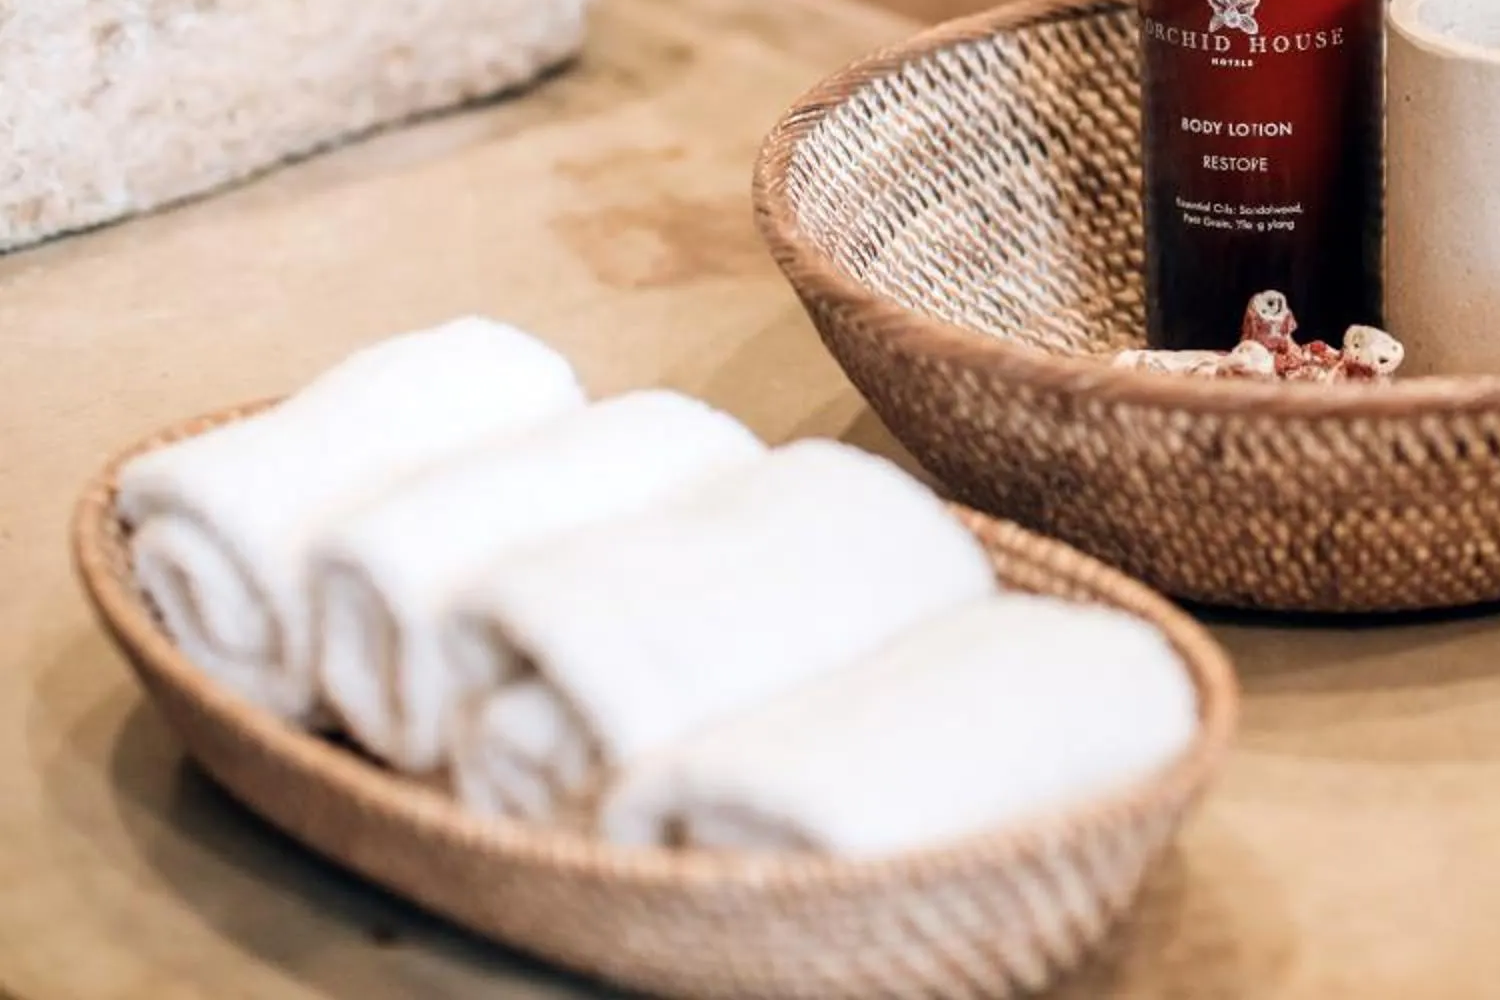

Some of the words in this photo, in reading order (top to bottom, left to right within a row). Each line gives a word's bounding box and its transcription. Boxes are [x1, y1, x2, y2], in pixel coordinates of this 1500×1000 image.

[1144, 17, 1231, 52] ORCHID
[1249, 27, 1344, 53] HOUSE
[1211, 57, 1254, 67] HOTELS
[1181, 116, 1223, 135] BODY
[1228, 122, 1293, 137] LOTION
[1203, 155, 1269, 172] RESTORE
